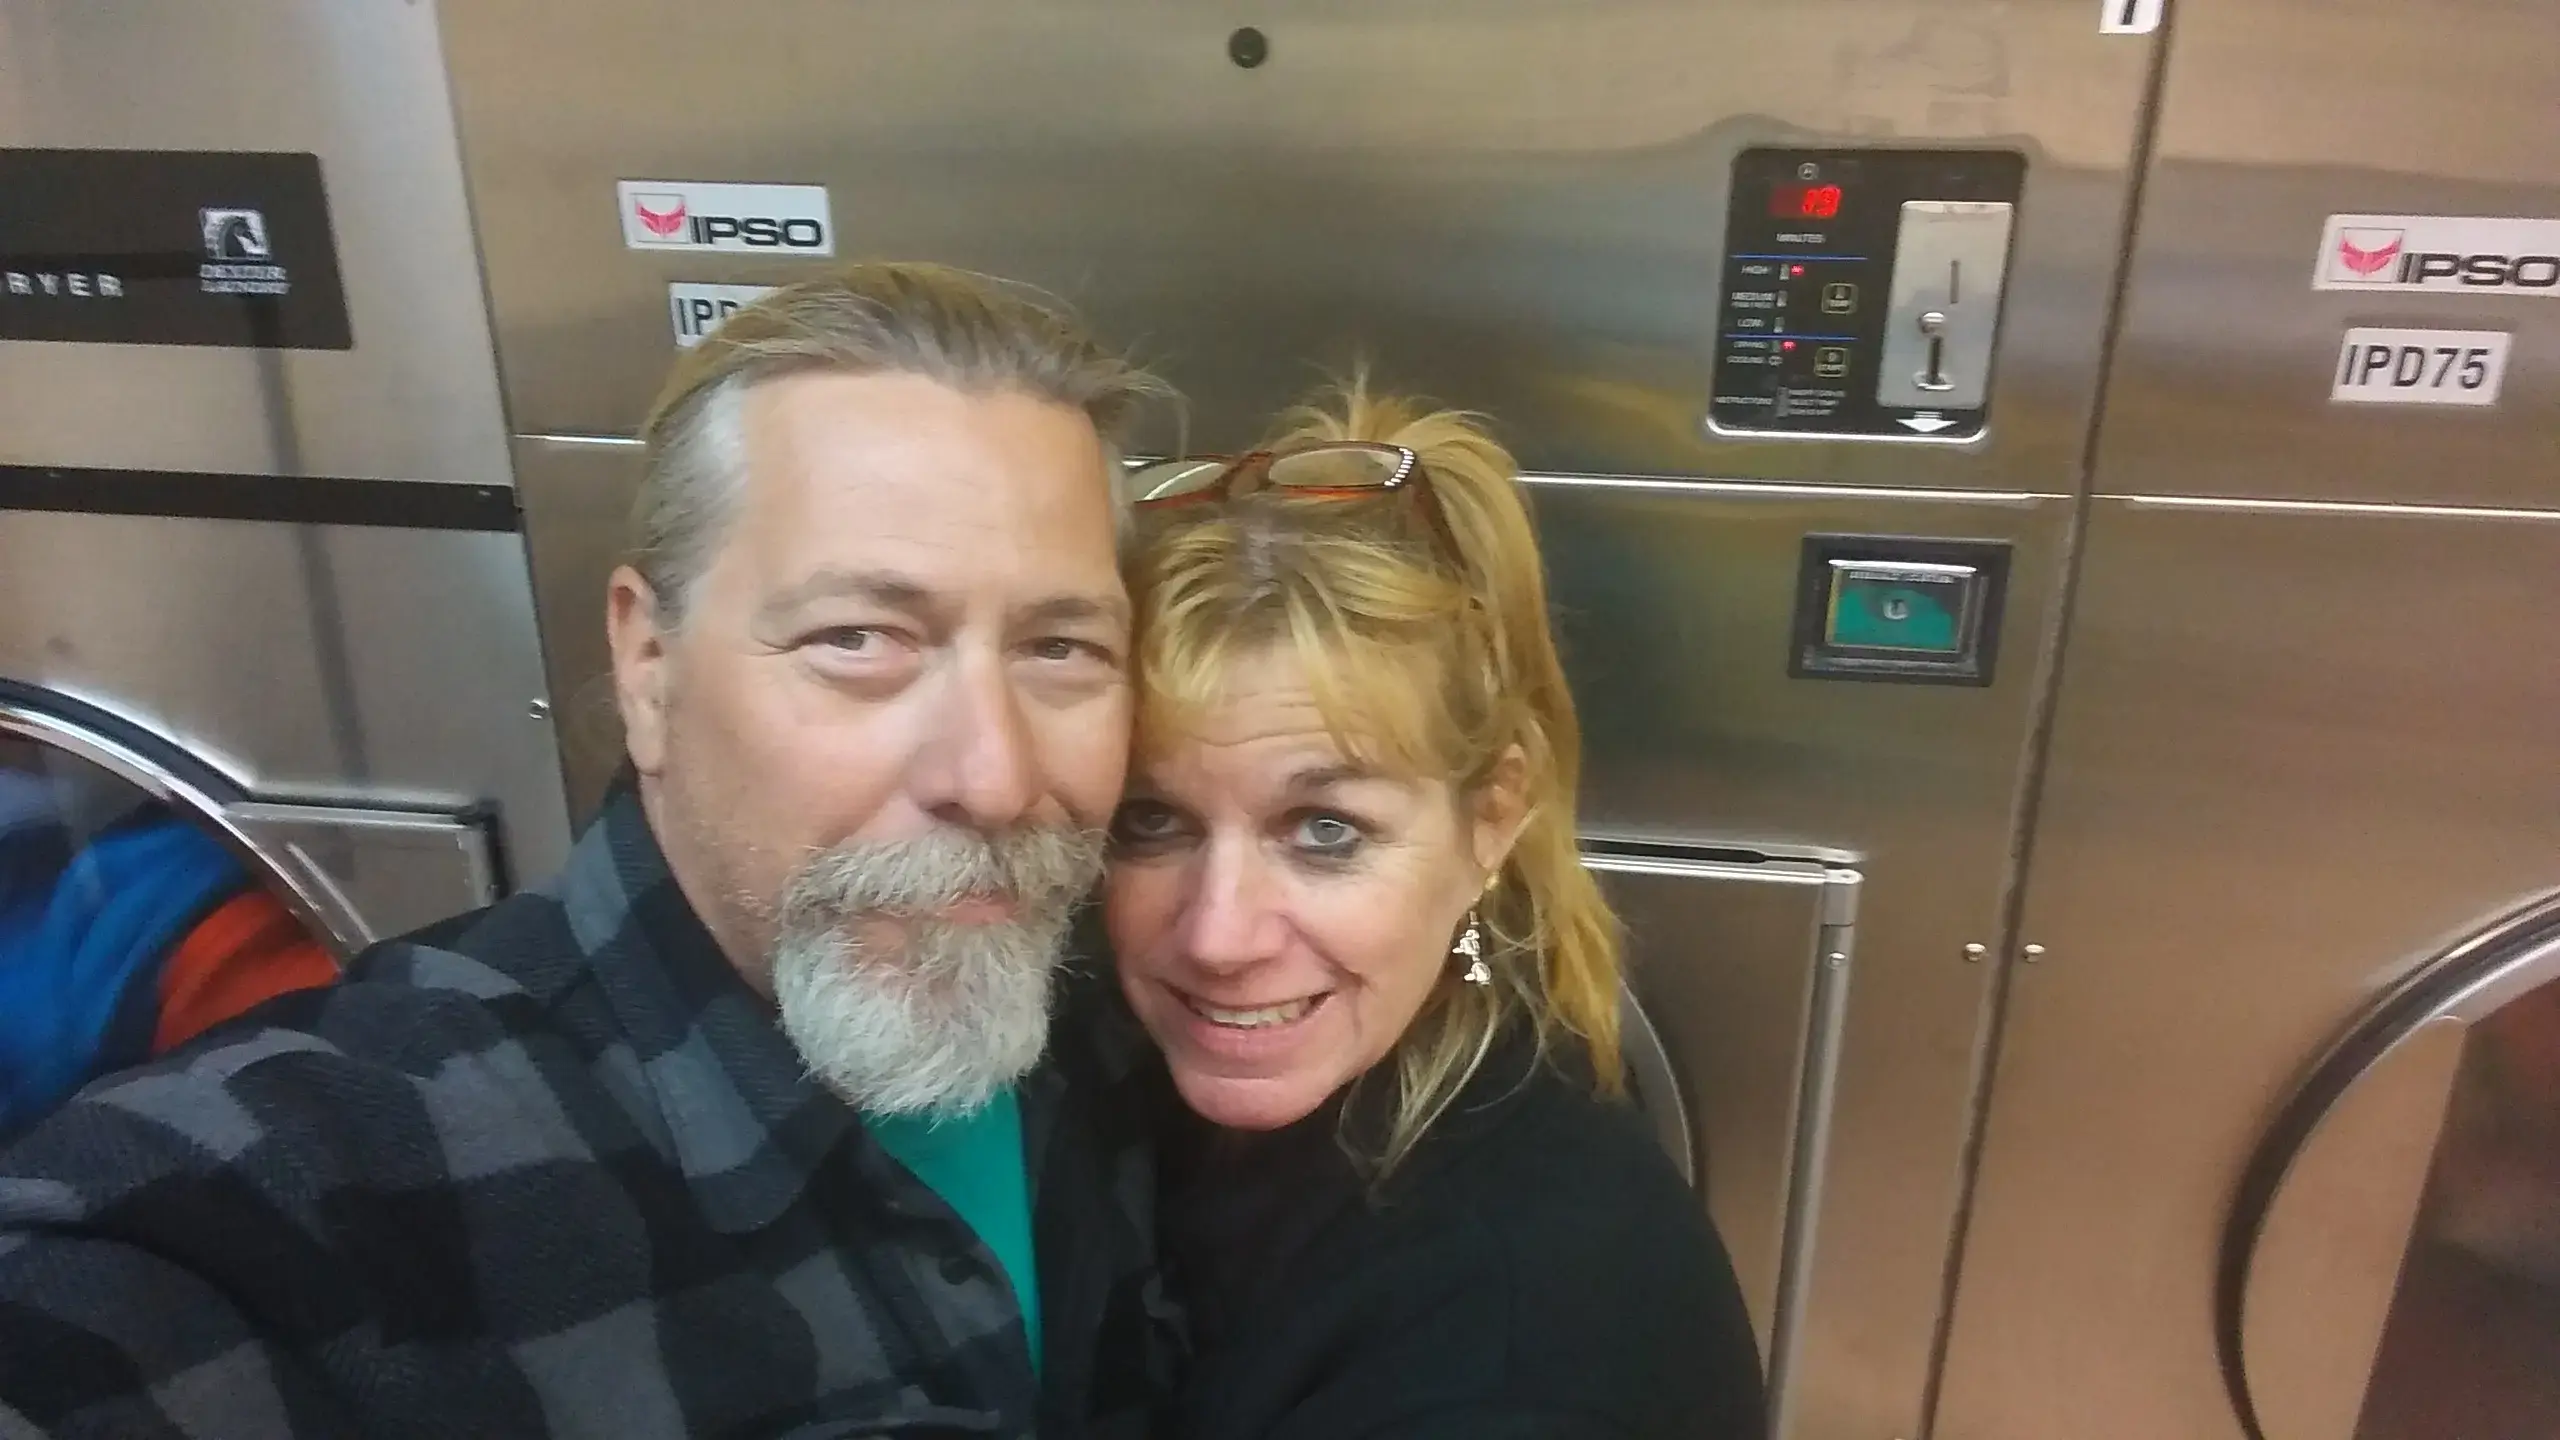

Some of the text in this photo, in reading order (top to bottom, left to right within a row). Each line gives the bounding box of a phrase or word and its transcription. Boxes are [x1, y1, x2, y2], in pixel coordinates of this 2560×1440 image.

[690, 215, 822, 247] IPSO
[2399, 252, 2560, 287] IPSO
[2341, 344, 2489, 390] IPD75
